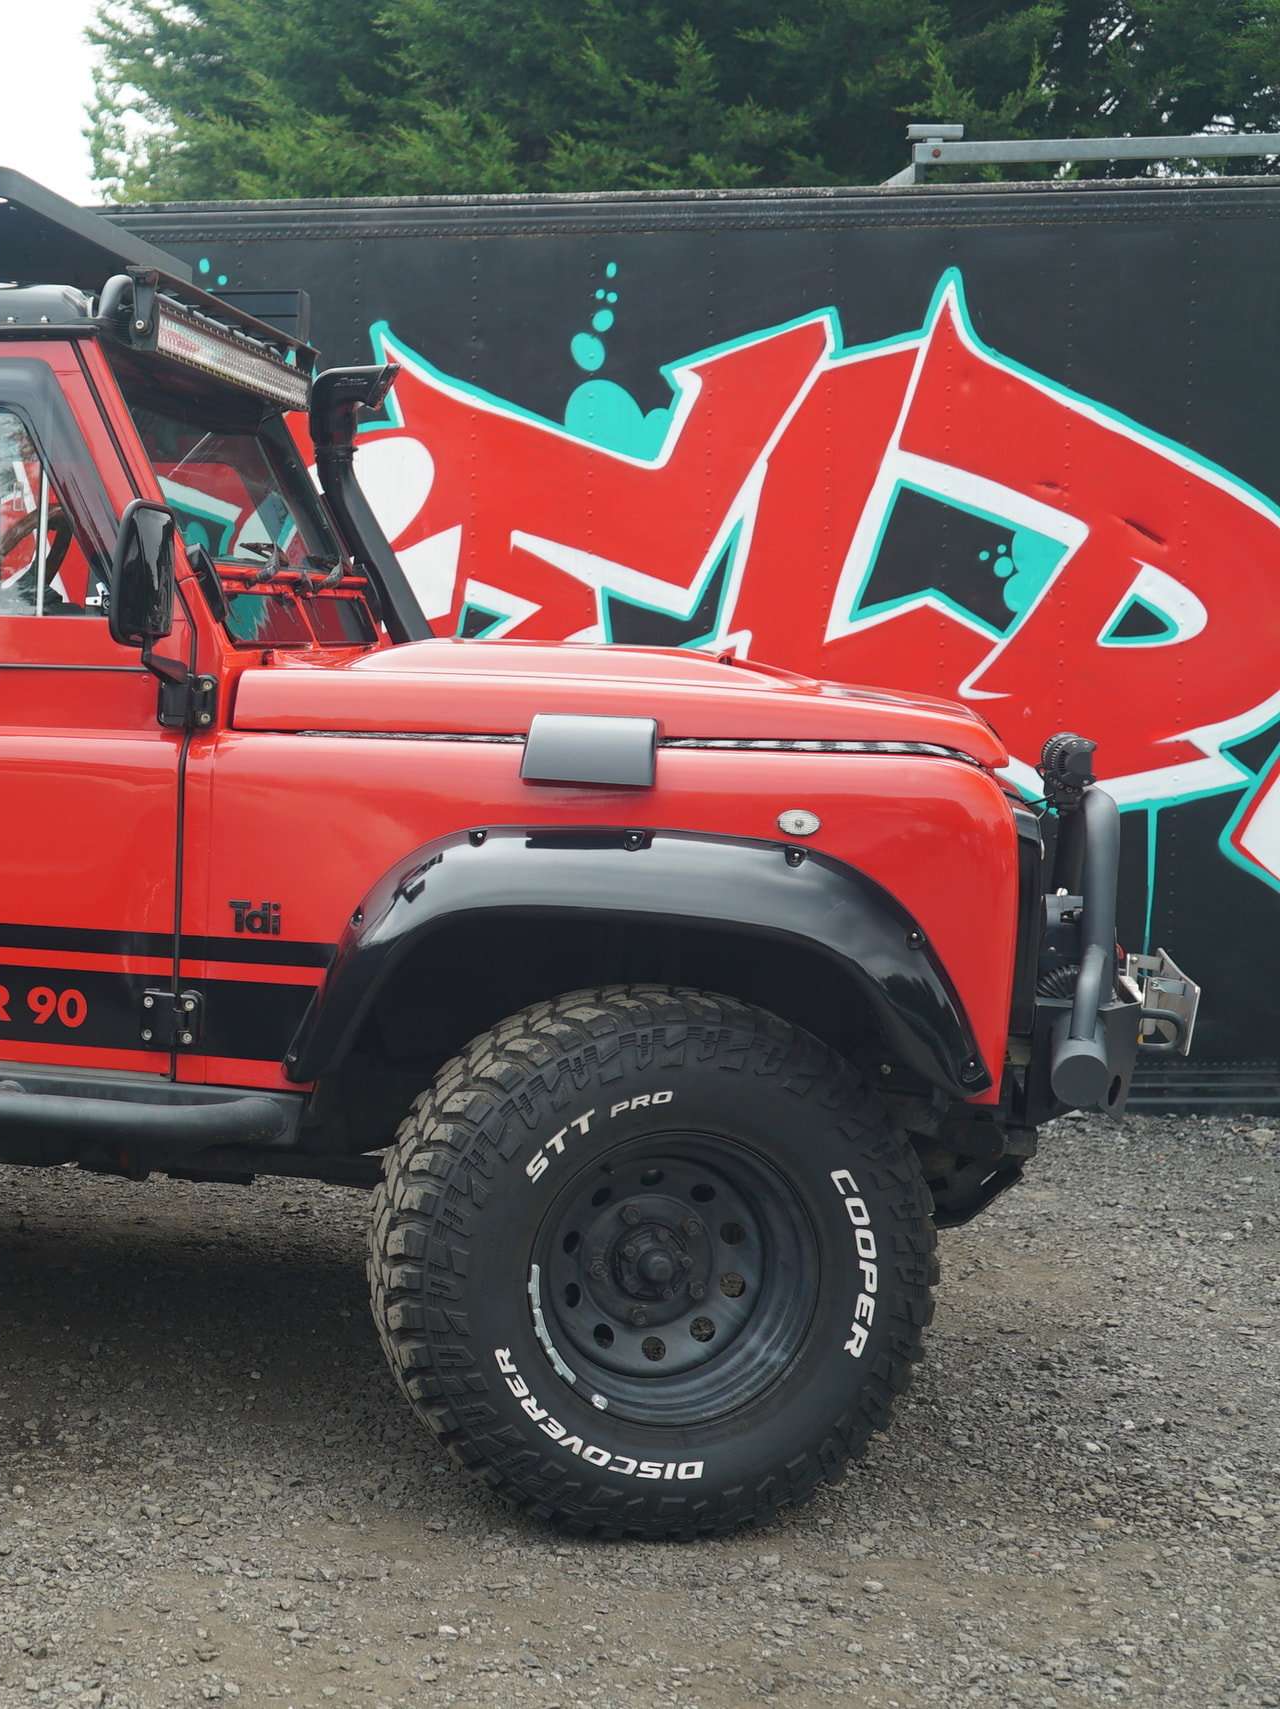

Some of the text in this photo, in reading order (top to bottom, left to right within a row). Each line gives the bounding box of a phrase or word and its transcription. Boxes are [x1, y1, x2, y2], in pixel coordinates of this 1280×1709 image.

[228, 899, 281, 936] Tdi
[26, 986, 88, 1028] 90
[524, 1090, 674, 1185] STT PRO
[829, 1168, 880, 1359] COOPER
[493, 1346, 705, 1482] DISCOVERER
